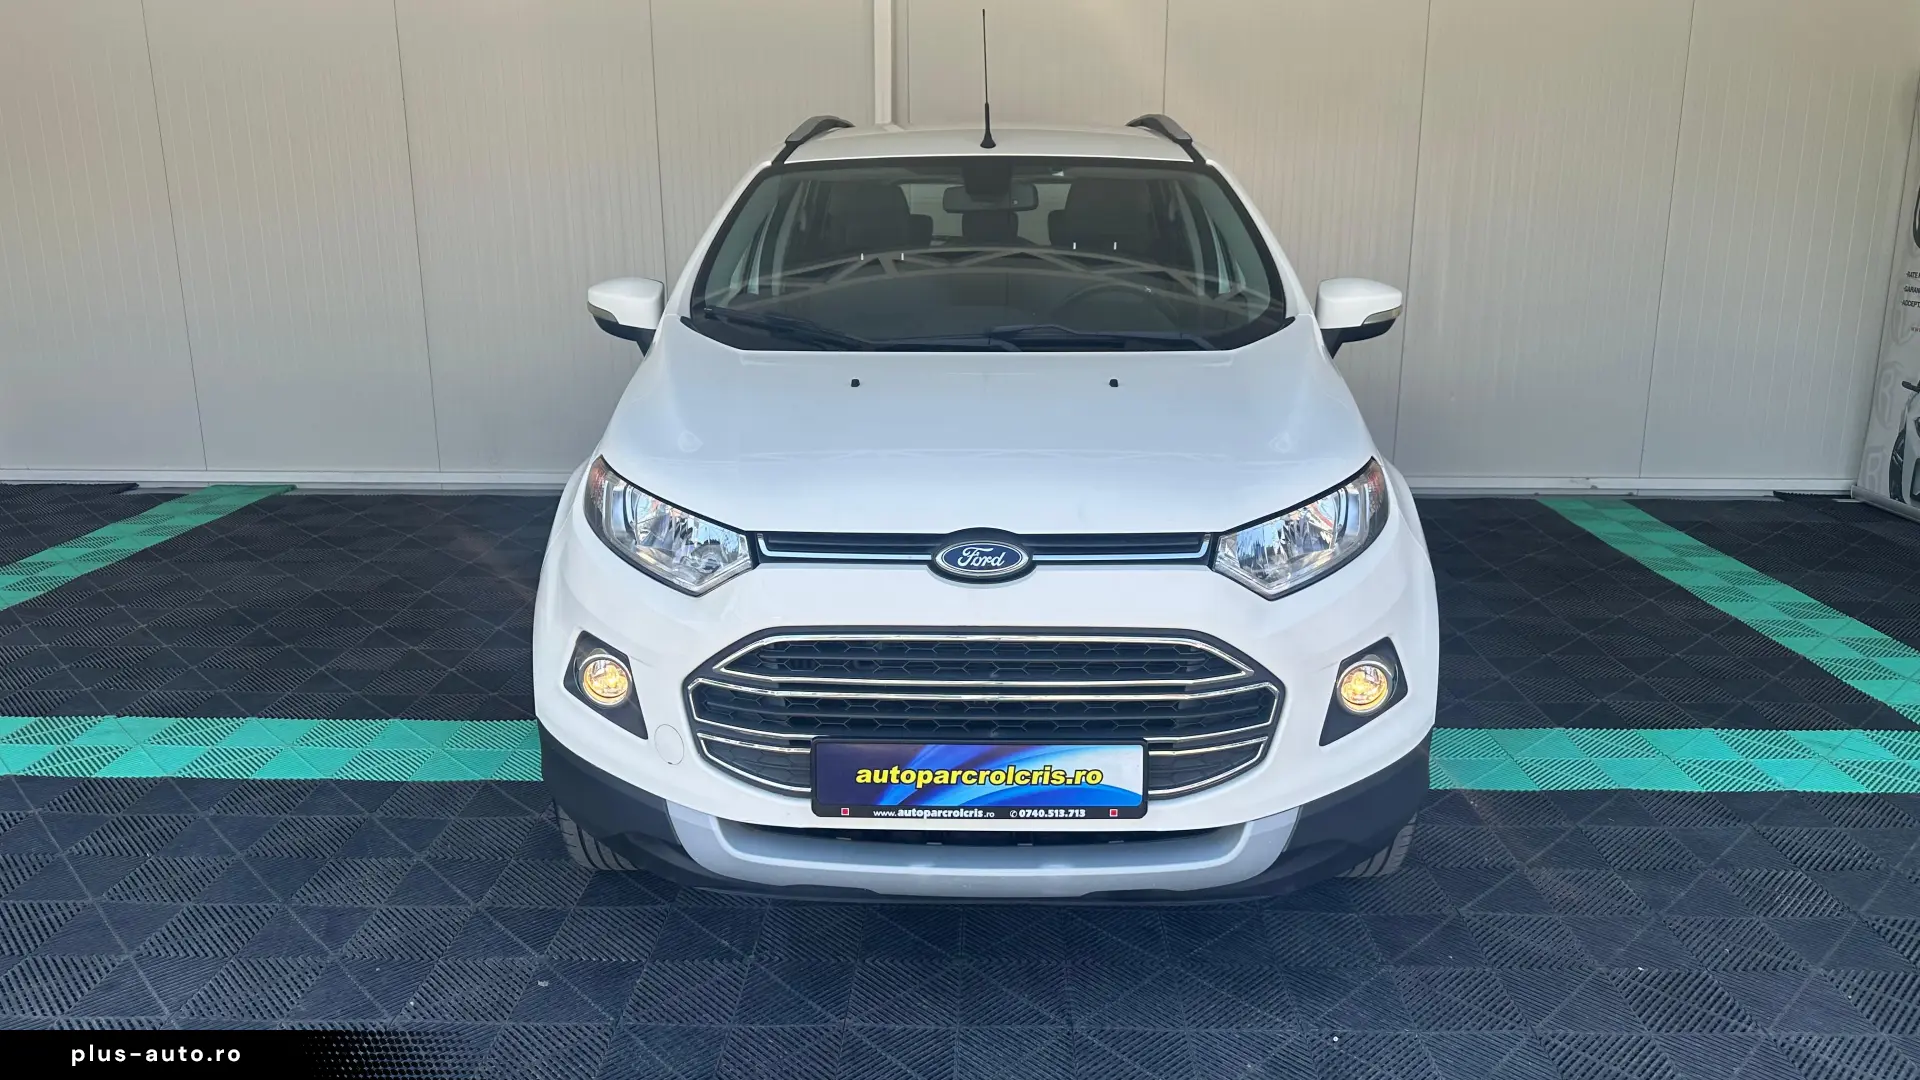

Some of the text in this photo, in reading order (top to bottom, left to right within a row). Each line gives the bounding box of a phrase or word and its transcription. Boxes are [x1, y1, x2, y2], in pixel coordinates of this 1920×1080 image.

[957, 546, 1006, 567] Ford
[855, 764, 1104, 788] autoparcrolcris.ro
[873, 808, 1086, 819] www.autoparcrolcris.ro 0740.513.713
